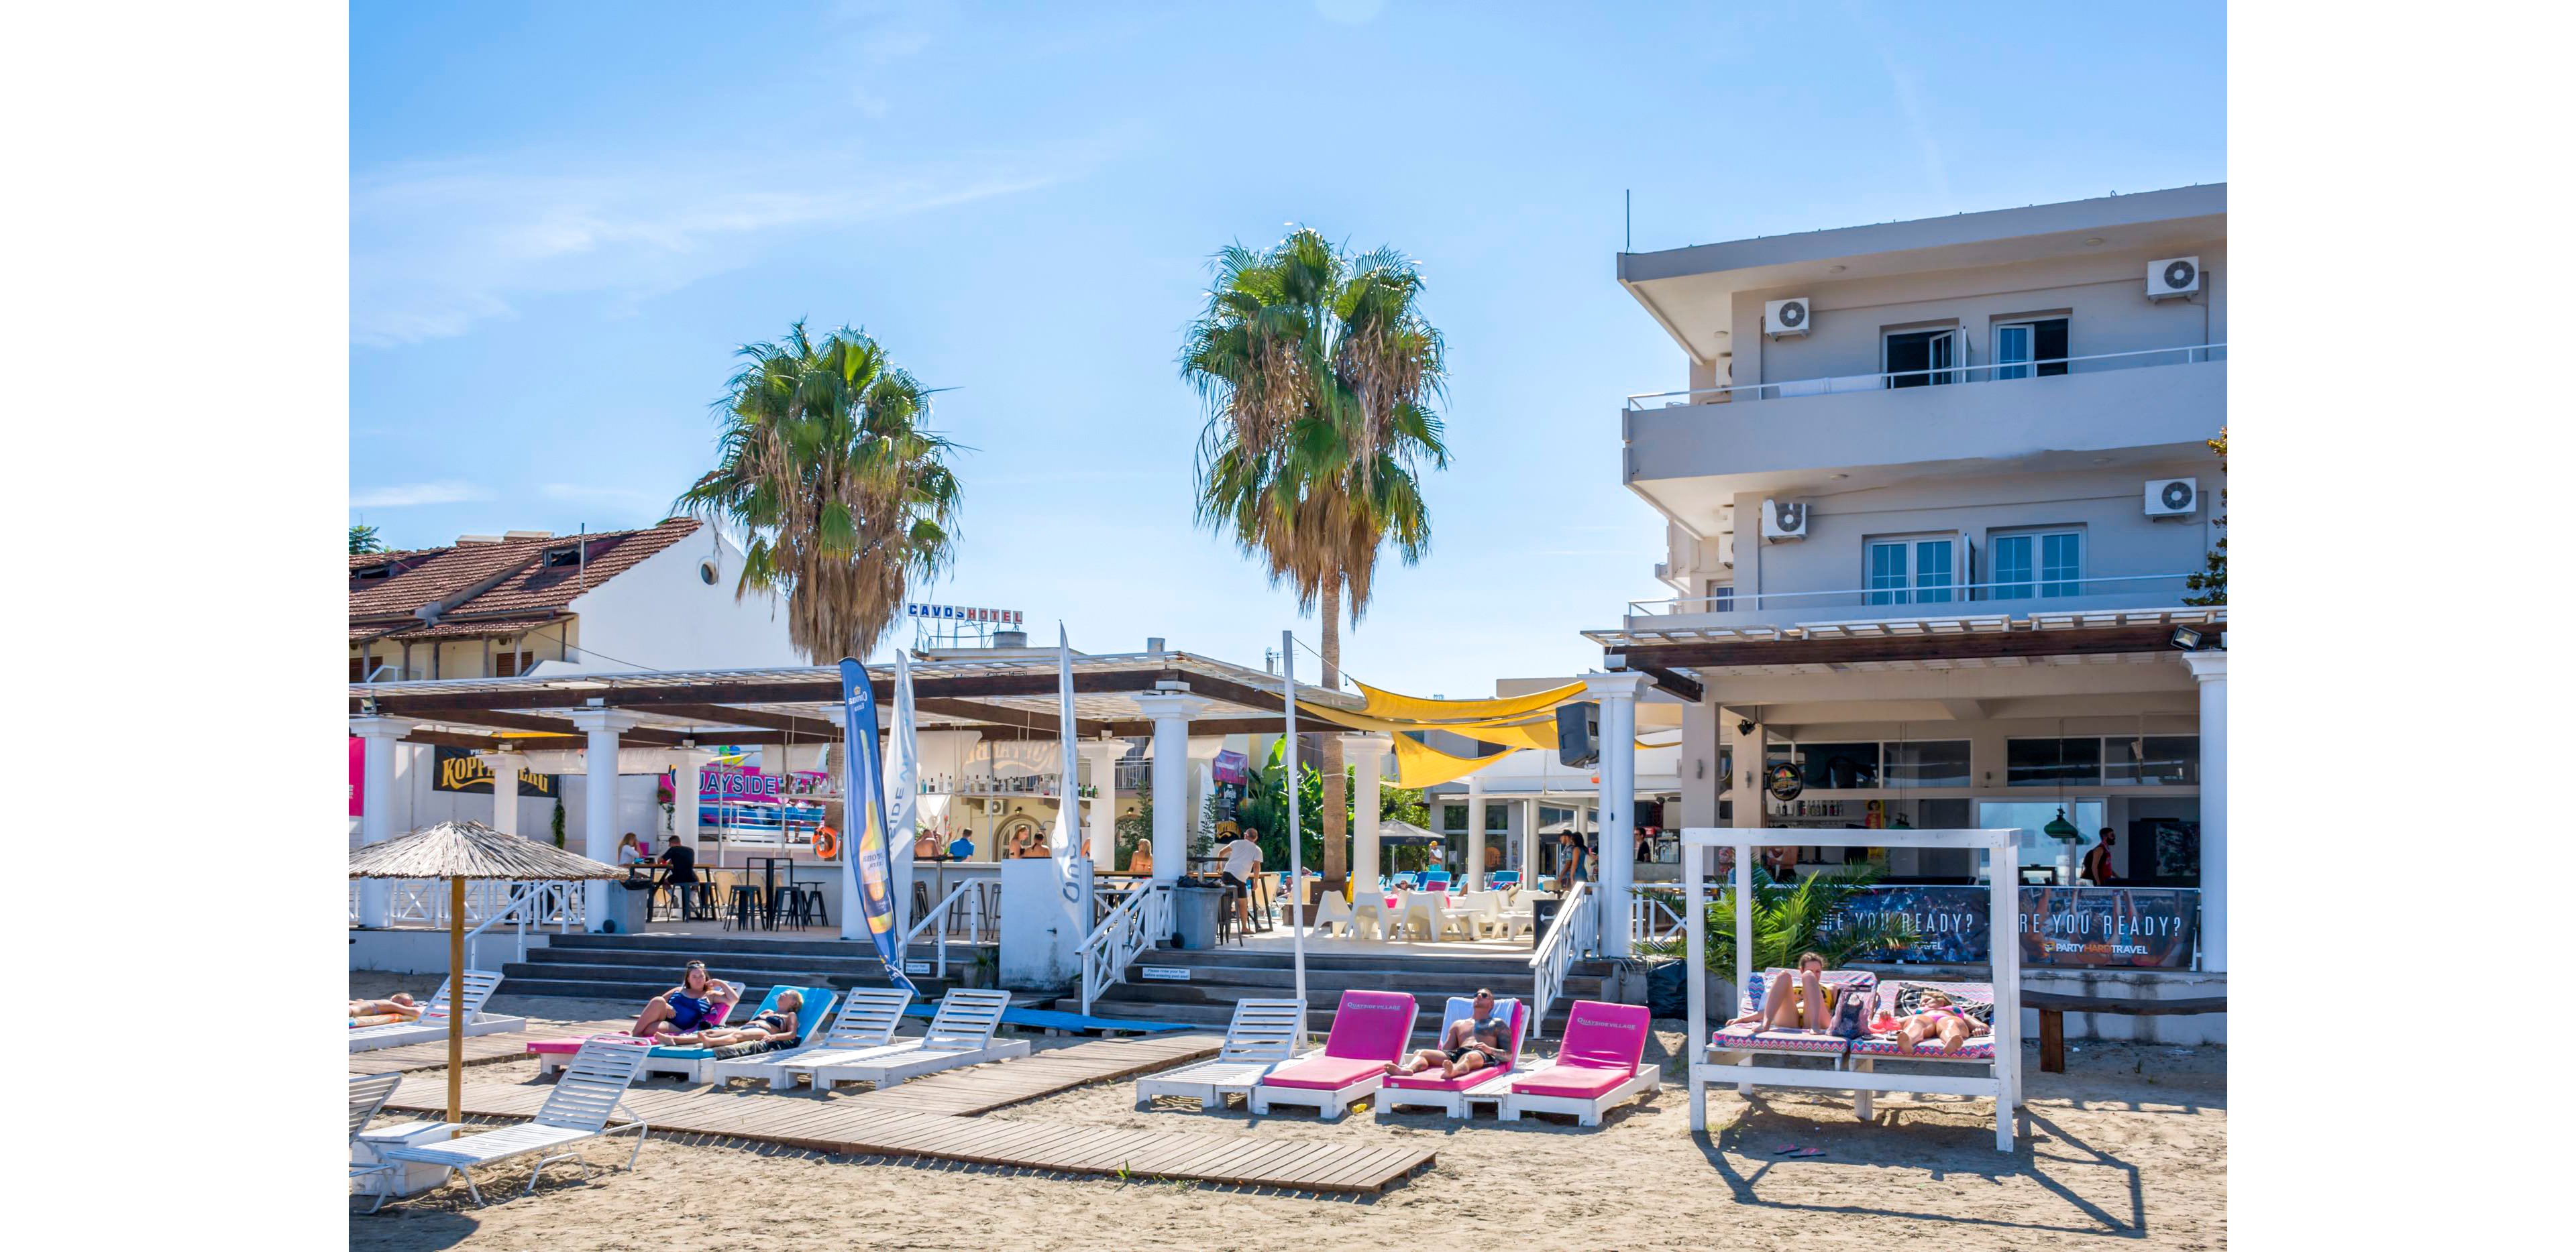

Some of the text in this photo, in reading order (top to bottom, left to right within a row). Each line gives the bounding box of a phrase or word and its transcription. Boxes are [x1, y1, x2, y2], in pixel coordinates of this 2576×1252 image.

[968, 608, 1022, 623] HOTEL
[1902, 912, 1973, 933] READY?
[2053, 914, 2090, 934] YOU
[2104, 915, 2181, 937] READY?
[1577, 1017, 1609, 1027] QUAYSIDE
